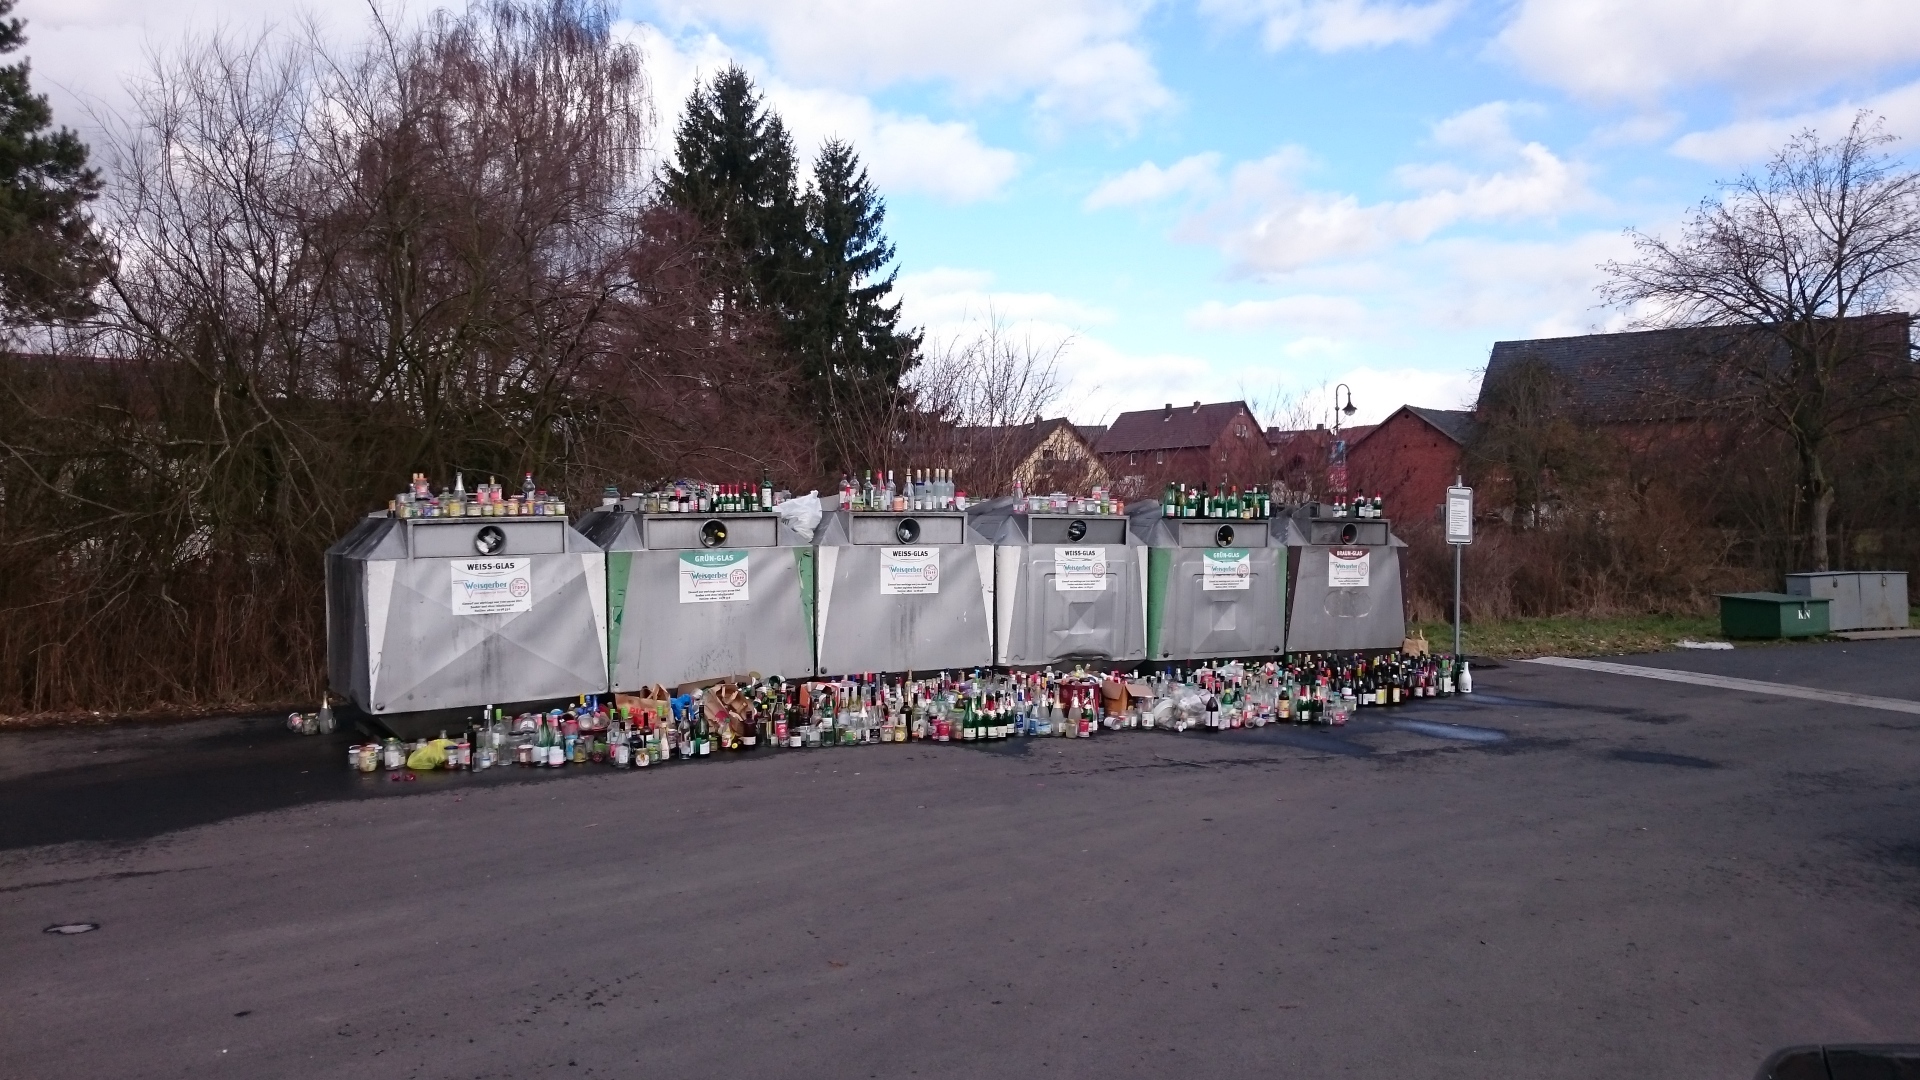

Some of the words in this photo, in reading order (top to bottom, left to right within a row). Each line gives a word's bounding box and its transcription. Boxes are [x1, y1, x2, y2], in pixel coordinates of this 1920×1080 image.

[694, 553, 734, 562] GRÜN-GLAS
[467, 562, 515, 570] WEISS-GLAS
[691, 572, 728, 580] Weisgerber
[465, 581, 507, 590] Weisgerber
